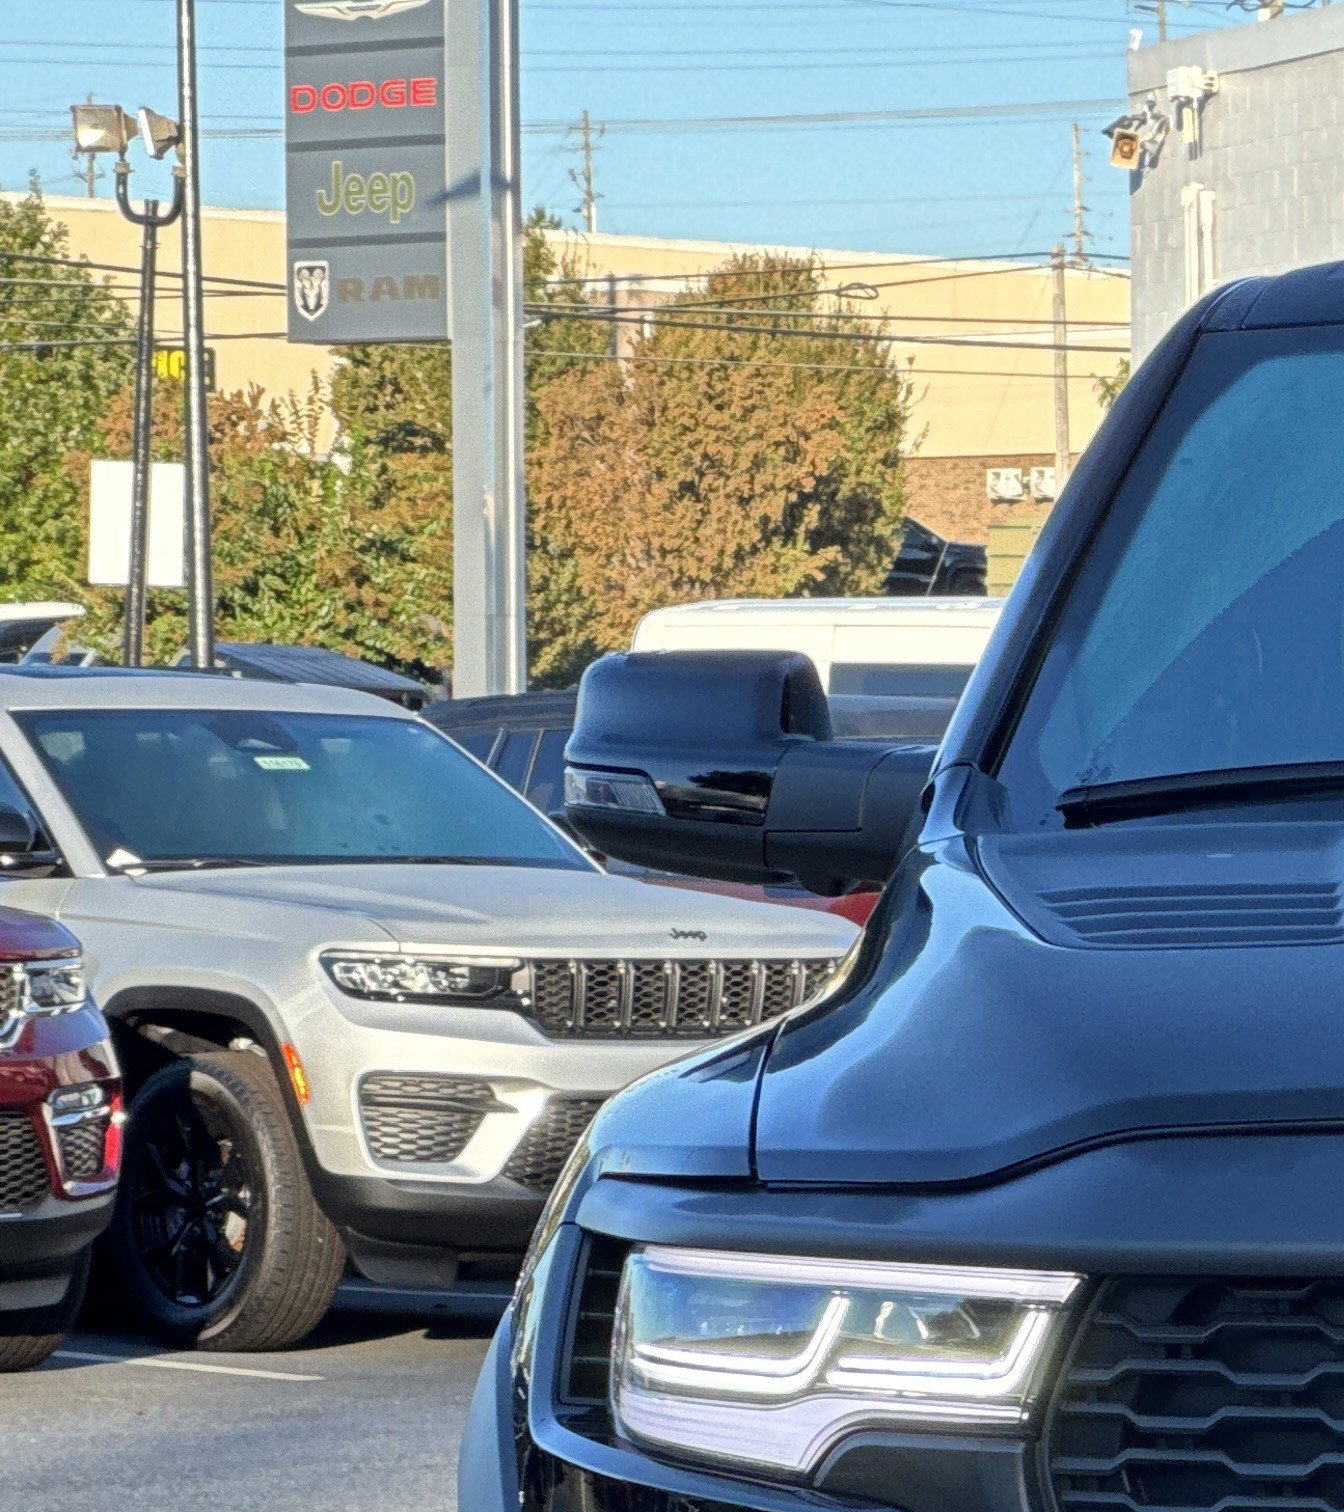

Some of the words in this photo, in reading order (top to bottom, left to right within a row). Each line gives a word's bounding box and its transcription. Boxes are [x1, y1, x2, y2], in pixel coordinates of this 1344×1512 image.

[290, 77, 437, 113] DODGE
[316, 160, 415, 224] Jeep
[336, 274, 441, 304] RAM
